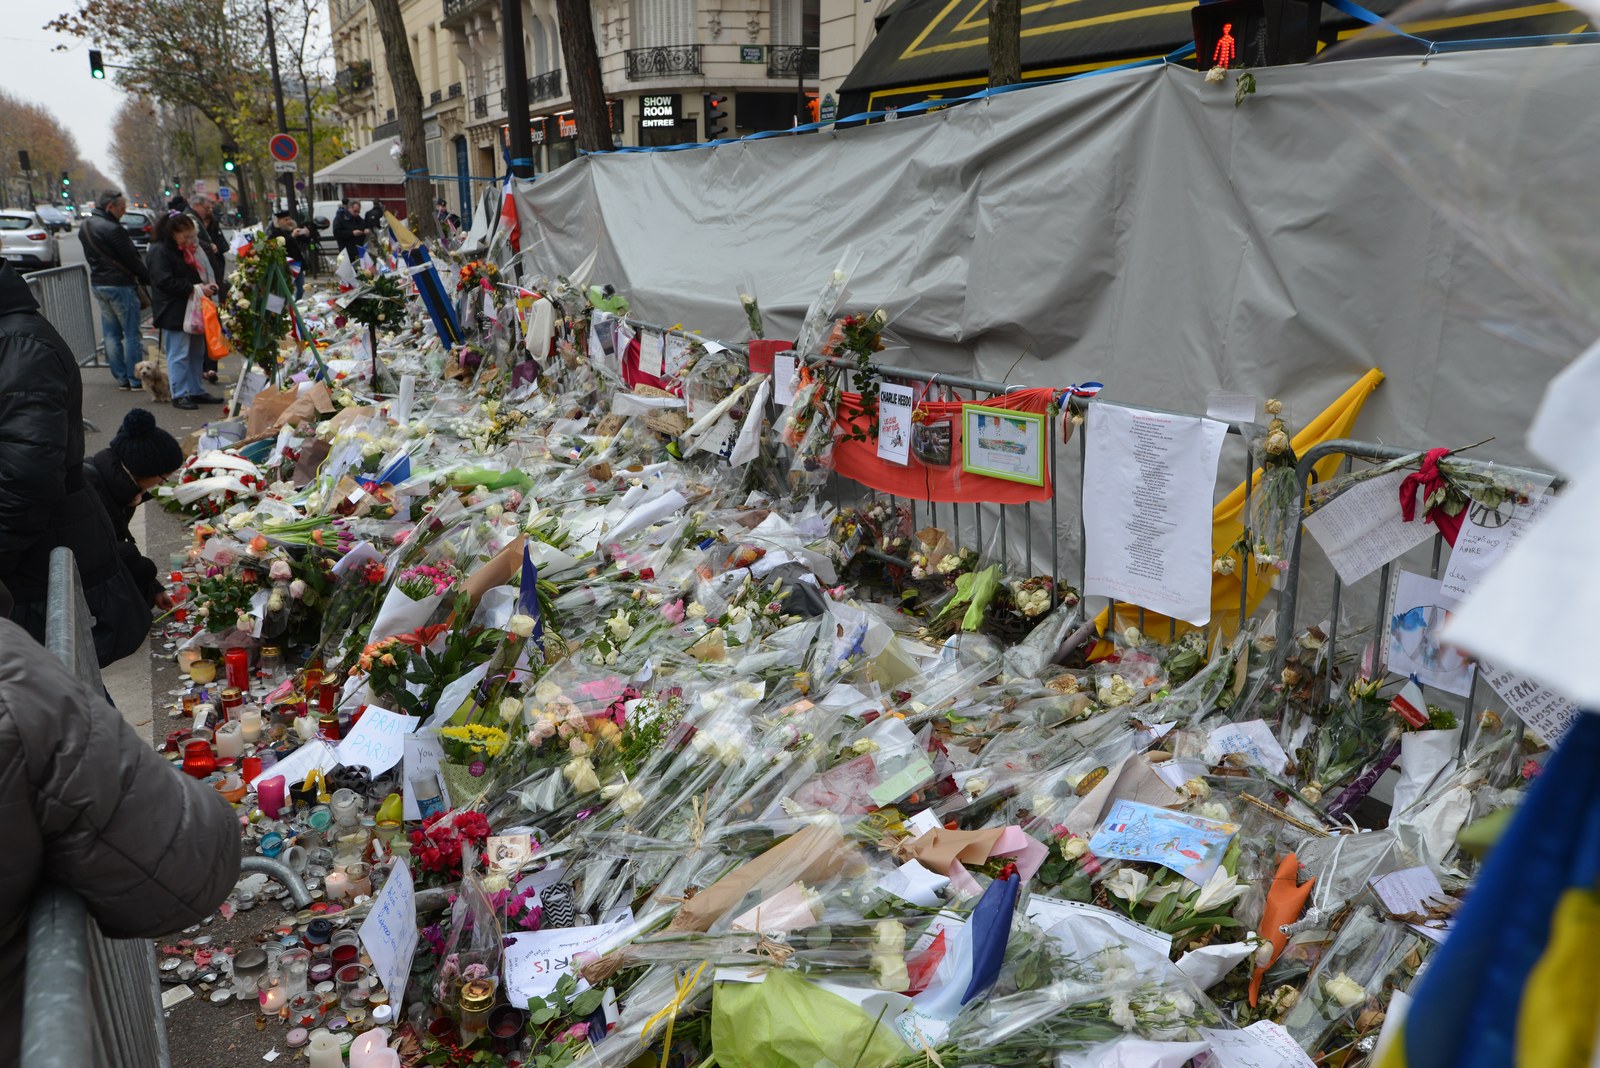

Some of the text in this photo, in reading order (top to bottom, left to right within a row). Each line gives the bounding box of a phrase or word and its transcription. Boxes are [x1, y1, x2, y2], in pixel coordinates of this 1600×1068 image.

[643, 96, 672, 106] SHOW
[643, 106, 673, 116] ROOM
[559, 118, 578, 140] Parque
[642, 118, 675, 127] ENTREE
[881, 391, 911, 407] CHARLIE HEBDO
[1503, 678, 1541, 706] FERMA
[1515, 688, 1556, 715] PORTIA
[1528, 696, 1566, 726] NOSTRO
[365, 711, 402, 737] PRAY
[350, 735, 391, 764] PARIS
[417, 747, 434, 764] You
